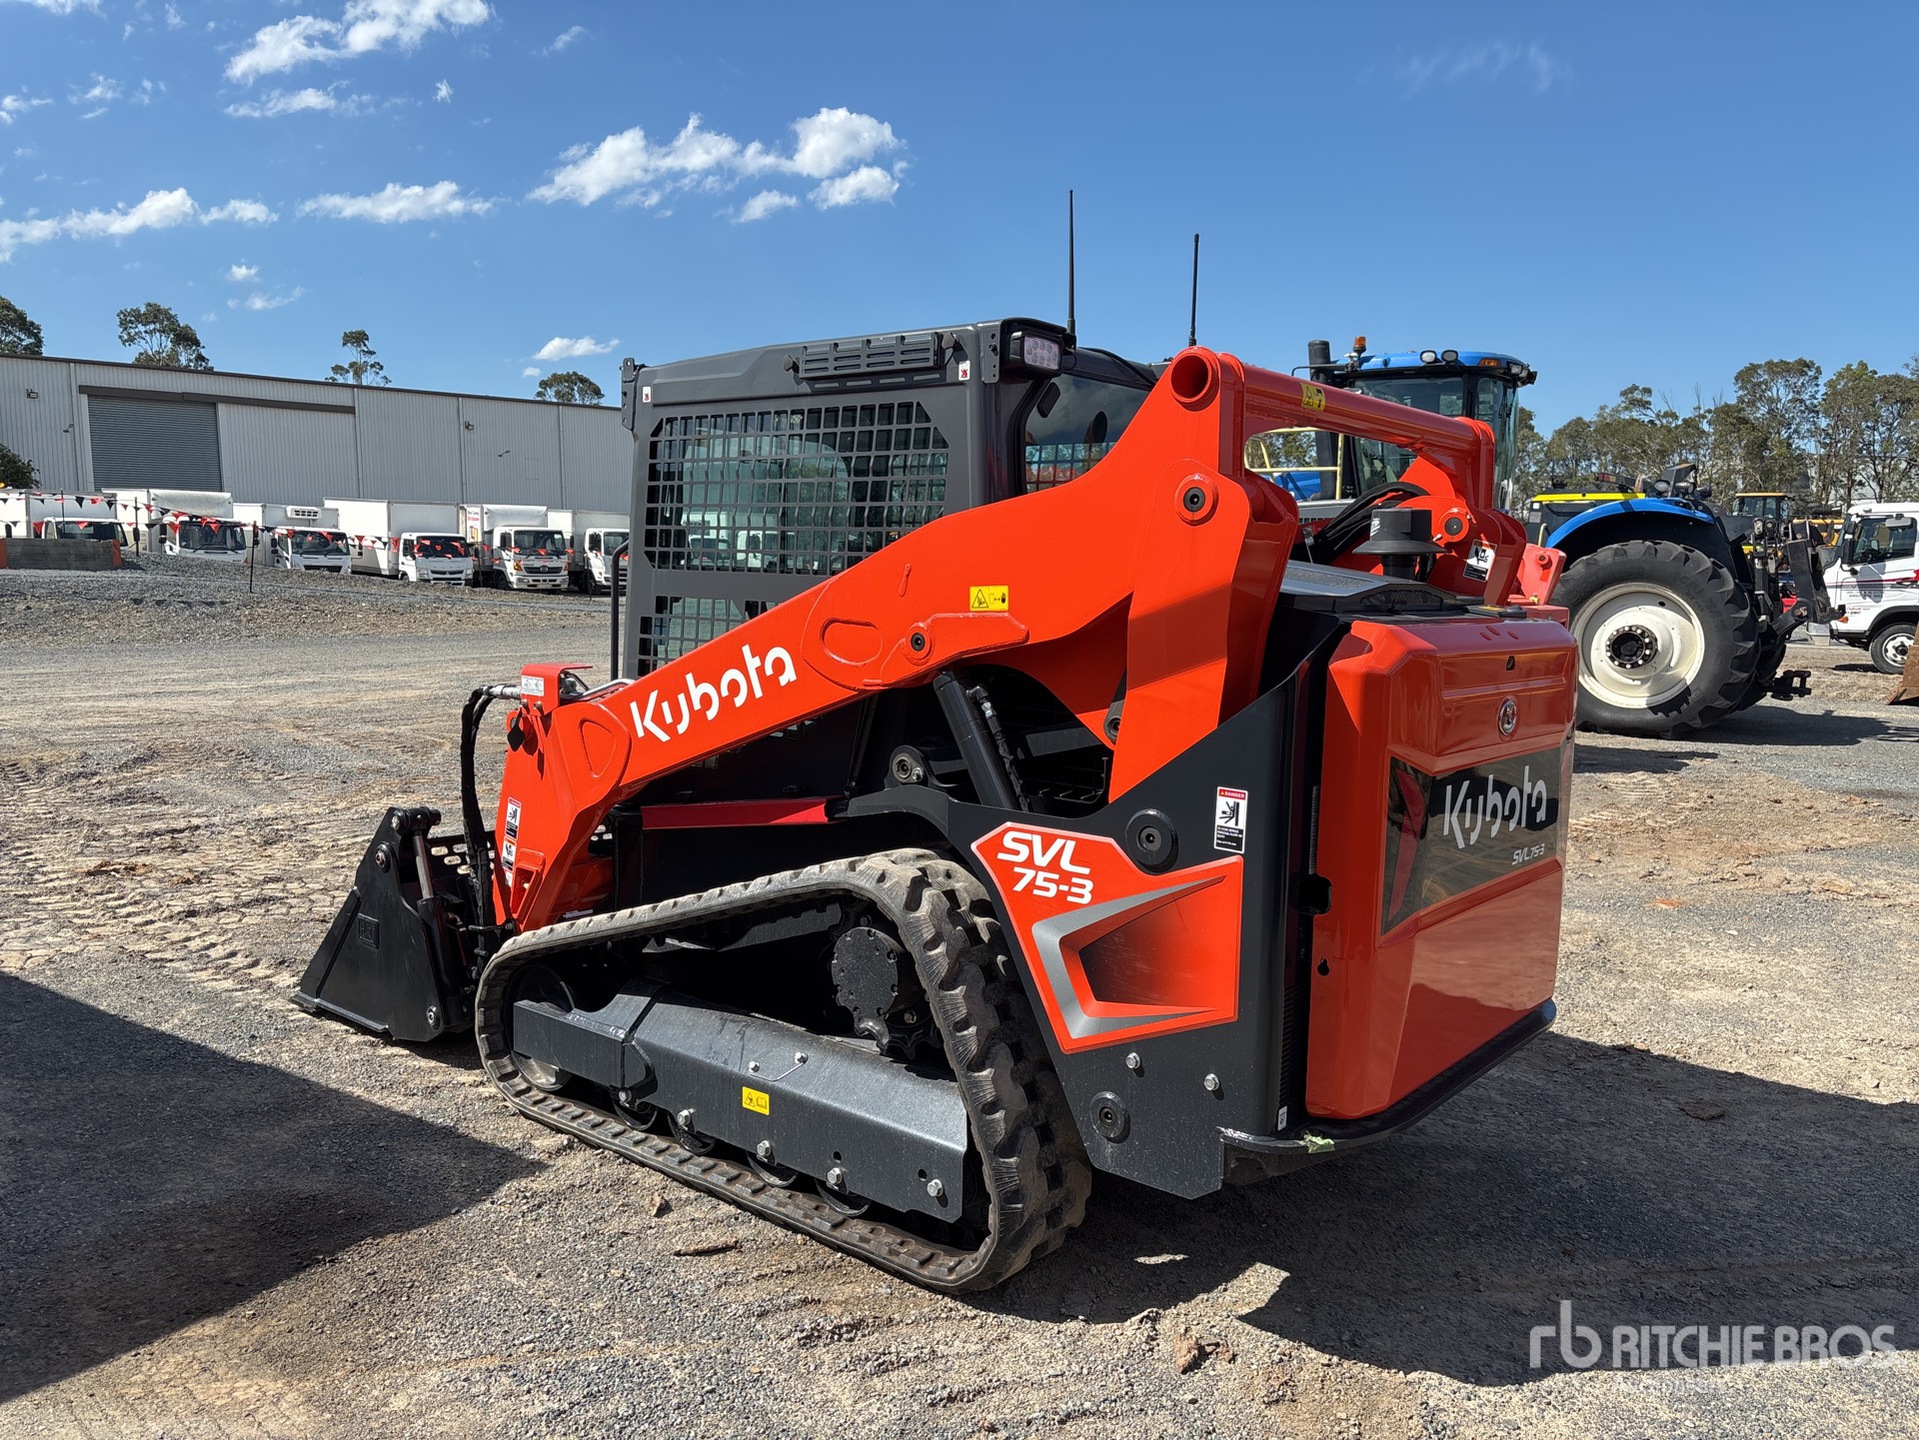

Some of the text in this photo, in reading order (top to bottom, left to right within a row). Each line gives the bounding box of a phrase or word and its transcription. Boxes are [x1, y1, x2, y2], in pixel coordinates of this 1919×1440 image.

[630, 644, 797, 742] Kubota
[1443, 765, 1548, 849] Kubota
[997, 831, 1090, 875] SVL
[1012, 867, 1094, 905] 75-3
